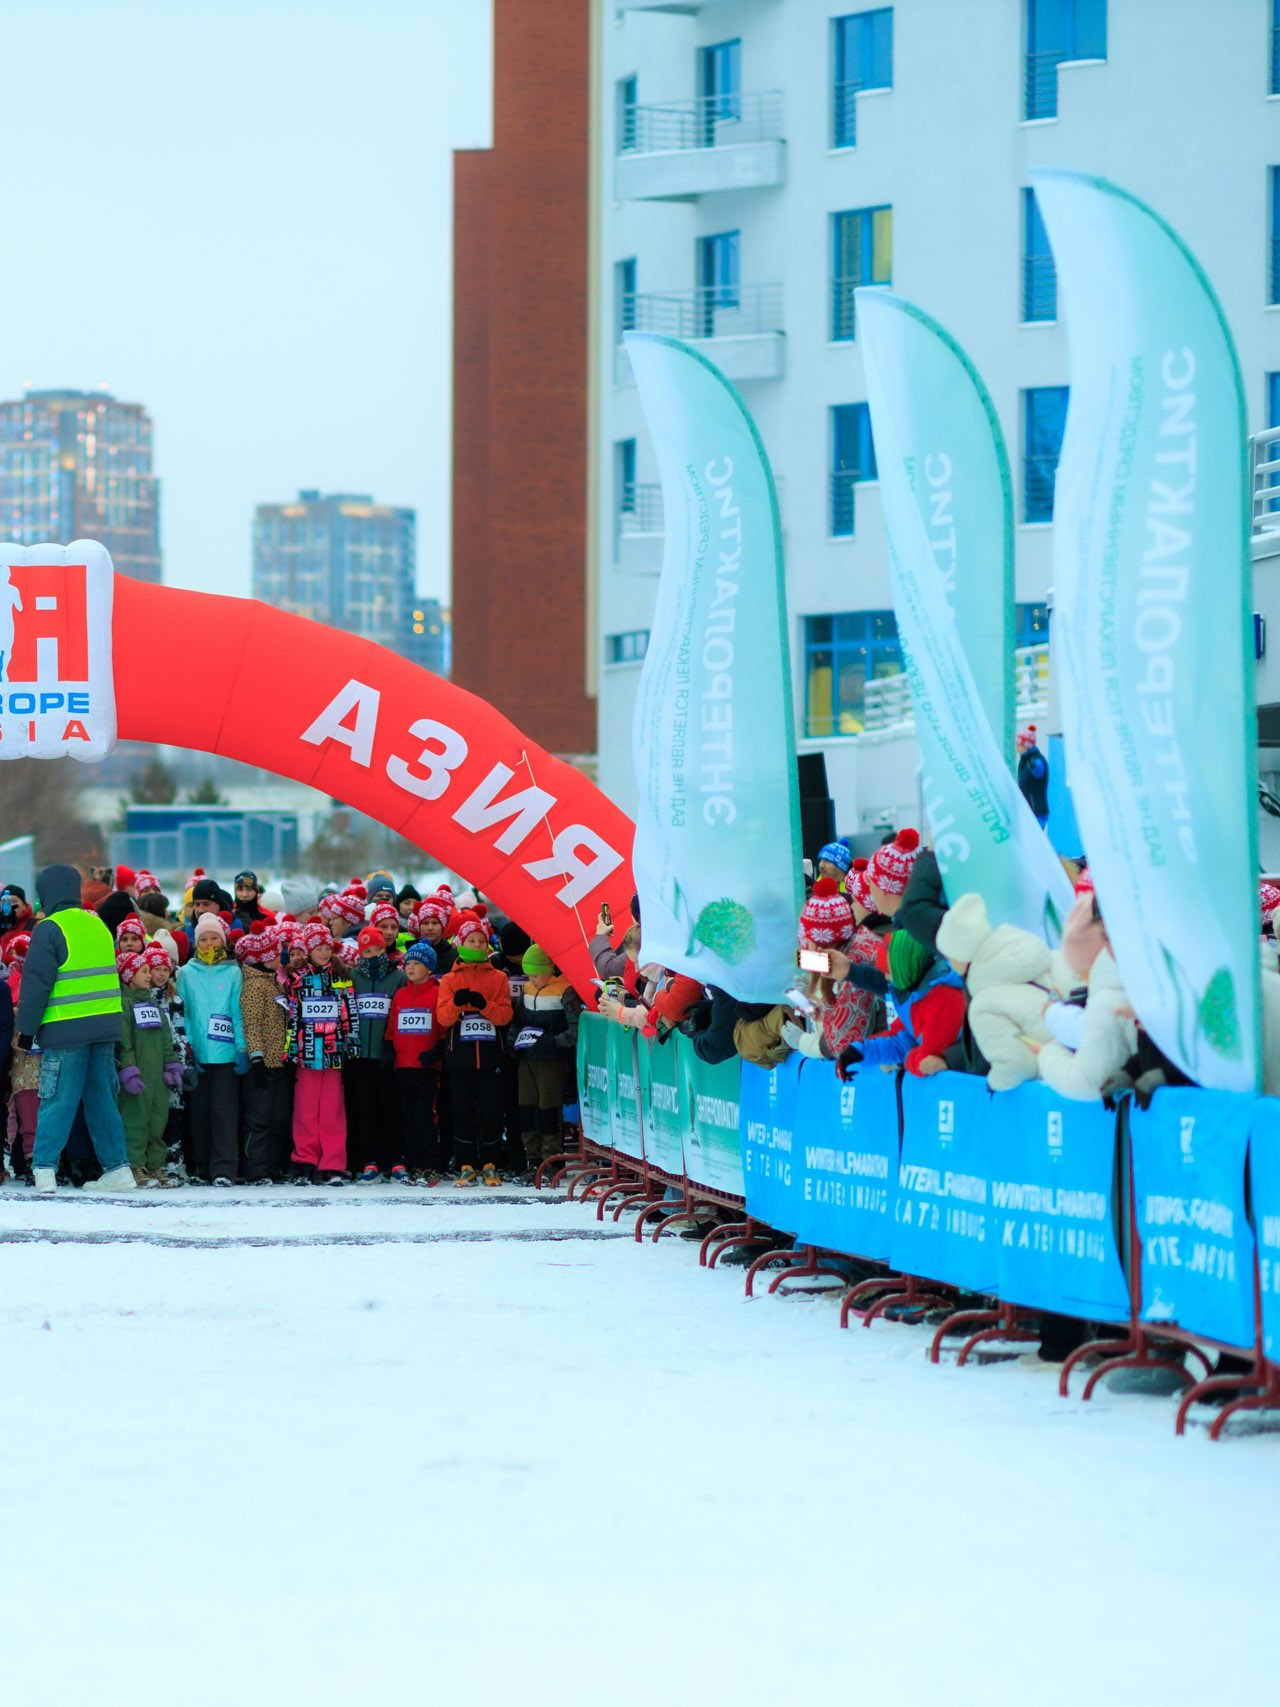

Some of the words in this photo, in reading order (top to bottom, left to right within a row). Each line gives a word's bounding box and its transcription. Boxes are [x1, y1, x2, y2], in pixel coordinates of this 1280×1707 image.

[299, 678, 625, 909] АЗИЯ
[306, 1005, 334, 1014] 5027
[358, 1000, 385, 1010] 5028
[402, 1016, 426, 1025] 5071
[465, 1022, 492, 1032] 5058
